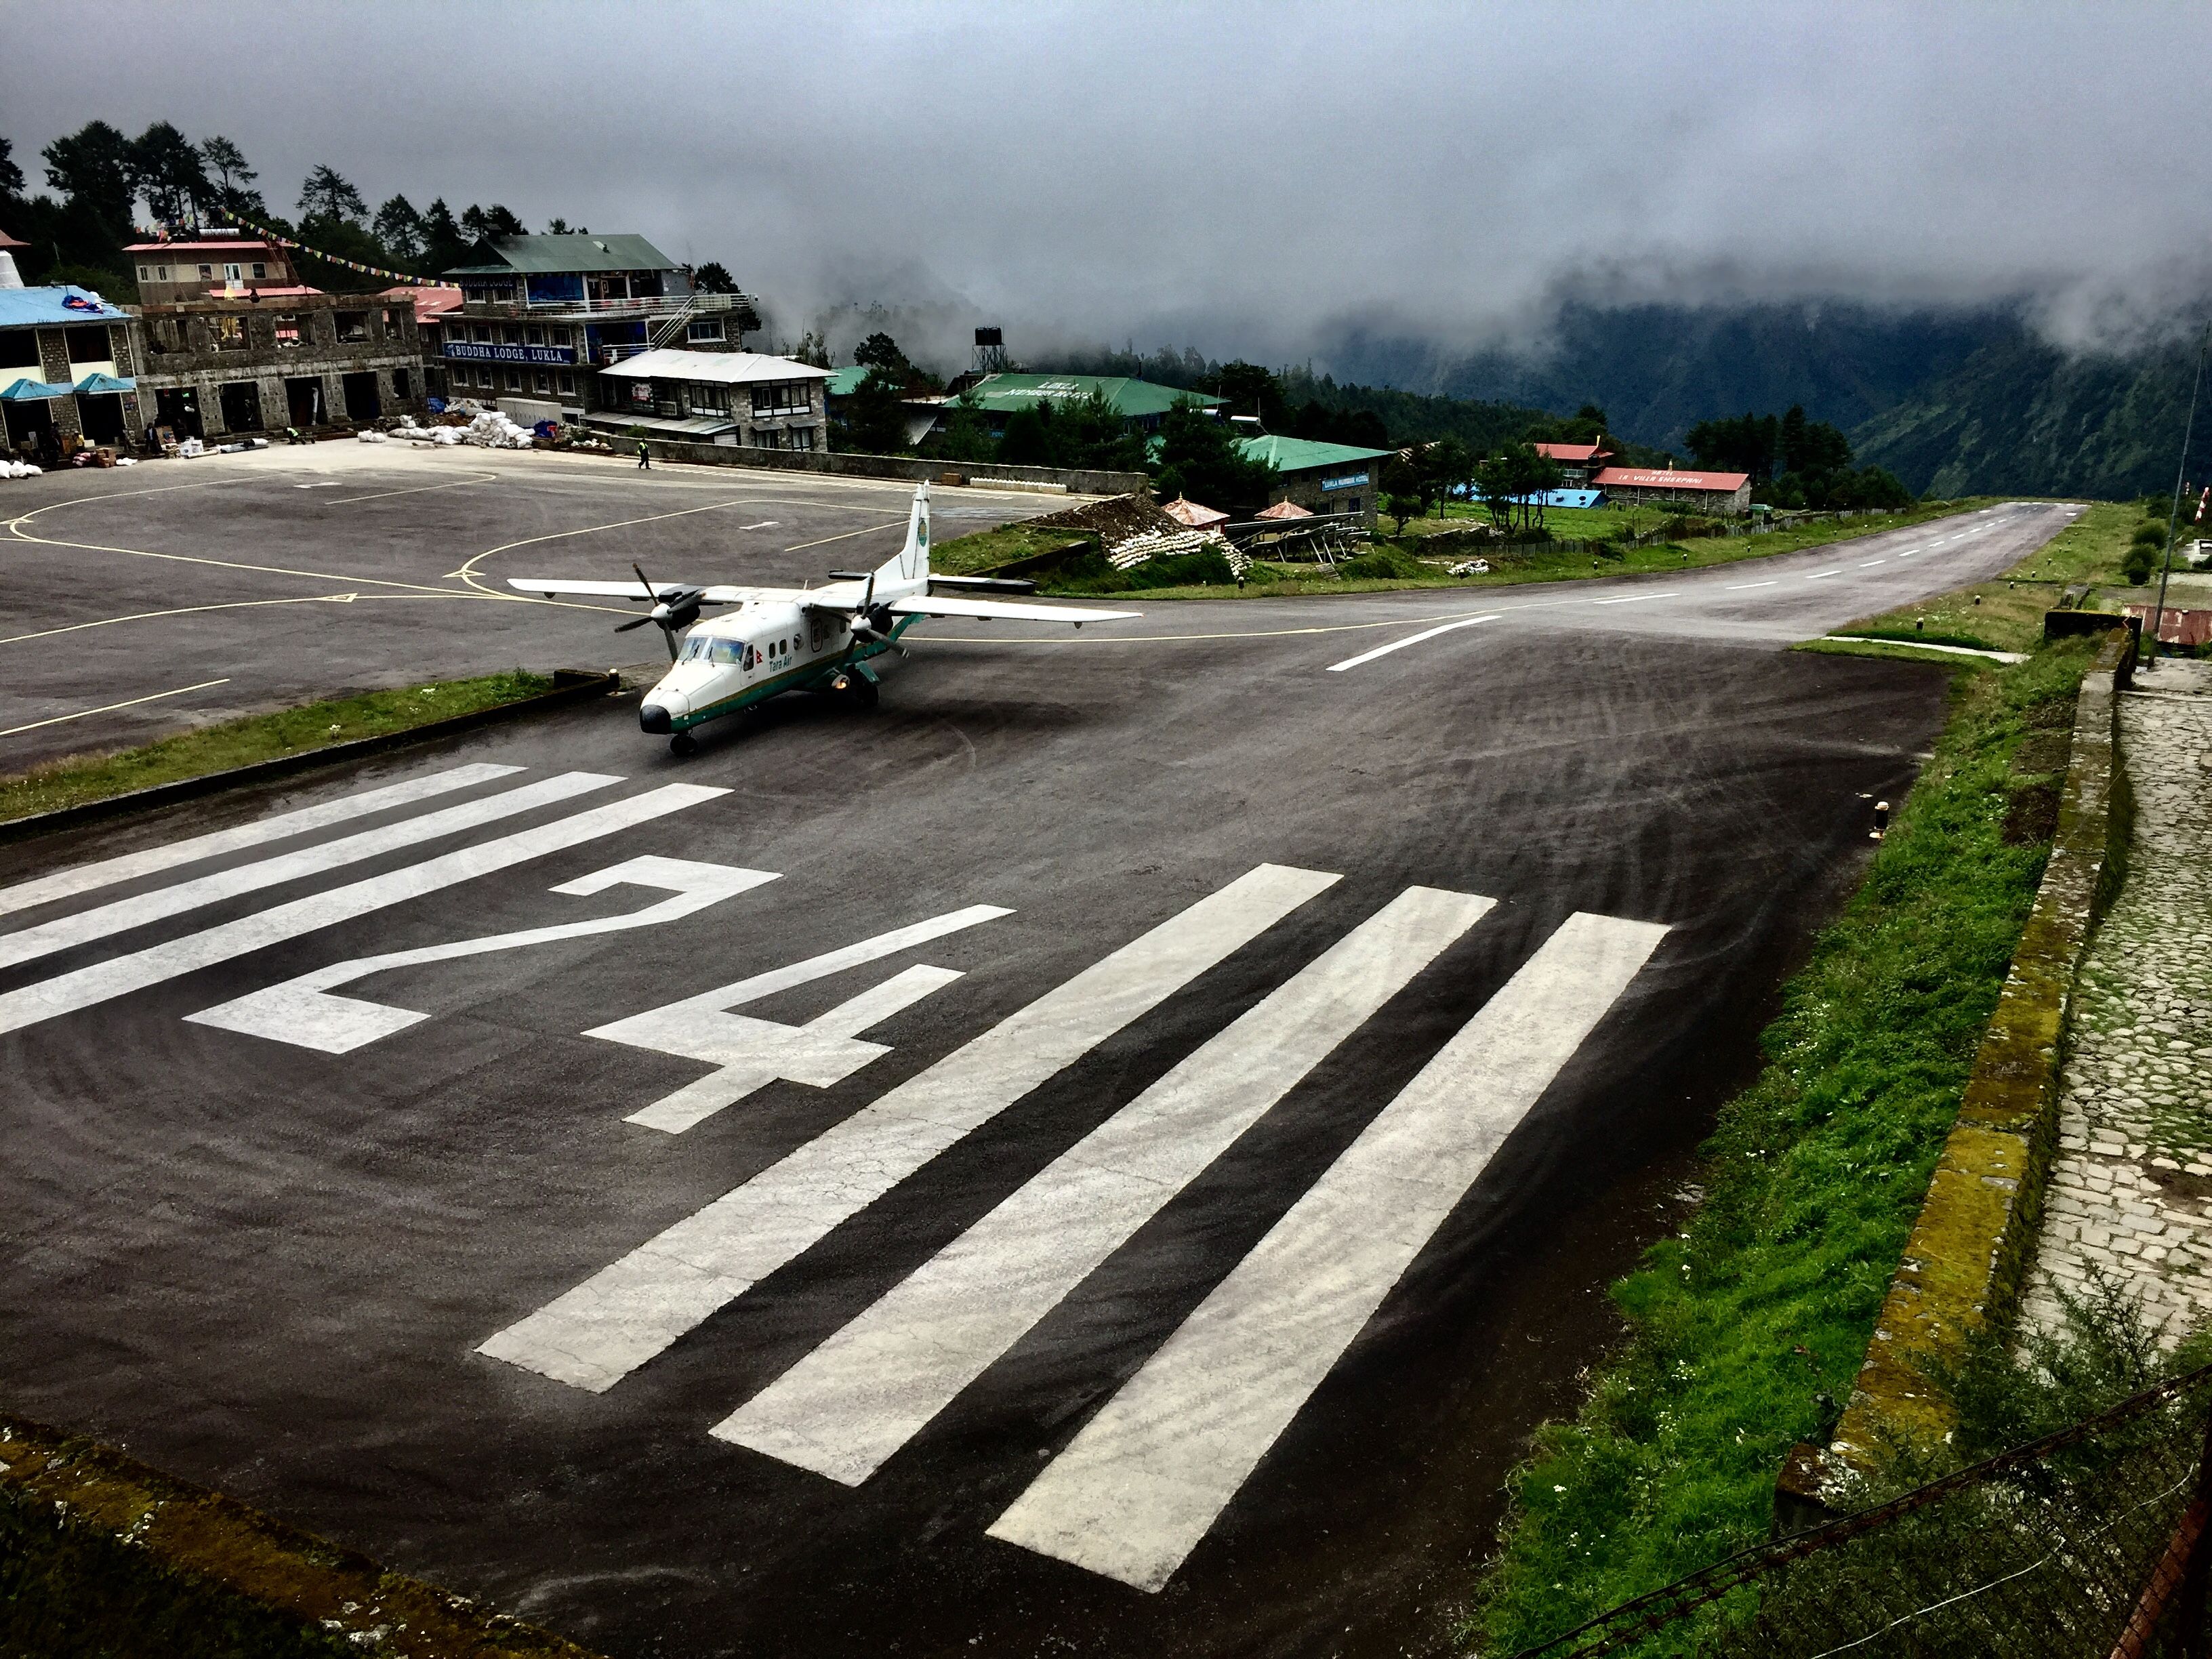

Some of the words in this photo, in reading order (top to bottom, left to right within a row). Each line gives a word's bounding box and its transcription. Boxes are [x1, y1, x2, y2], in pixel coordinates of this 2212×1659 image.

[455, 345, 491, 357] BUDDHA
[495, 348, 528, 362] LODGE,
[531, 349, 562, 361] LUKLA
[769, 660, 782, 672] Tara
[783, 655, 792, 668] Air
[182, 855, 1017, 1134] 24
